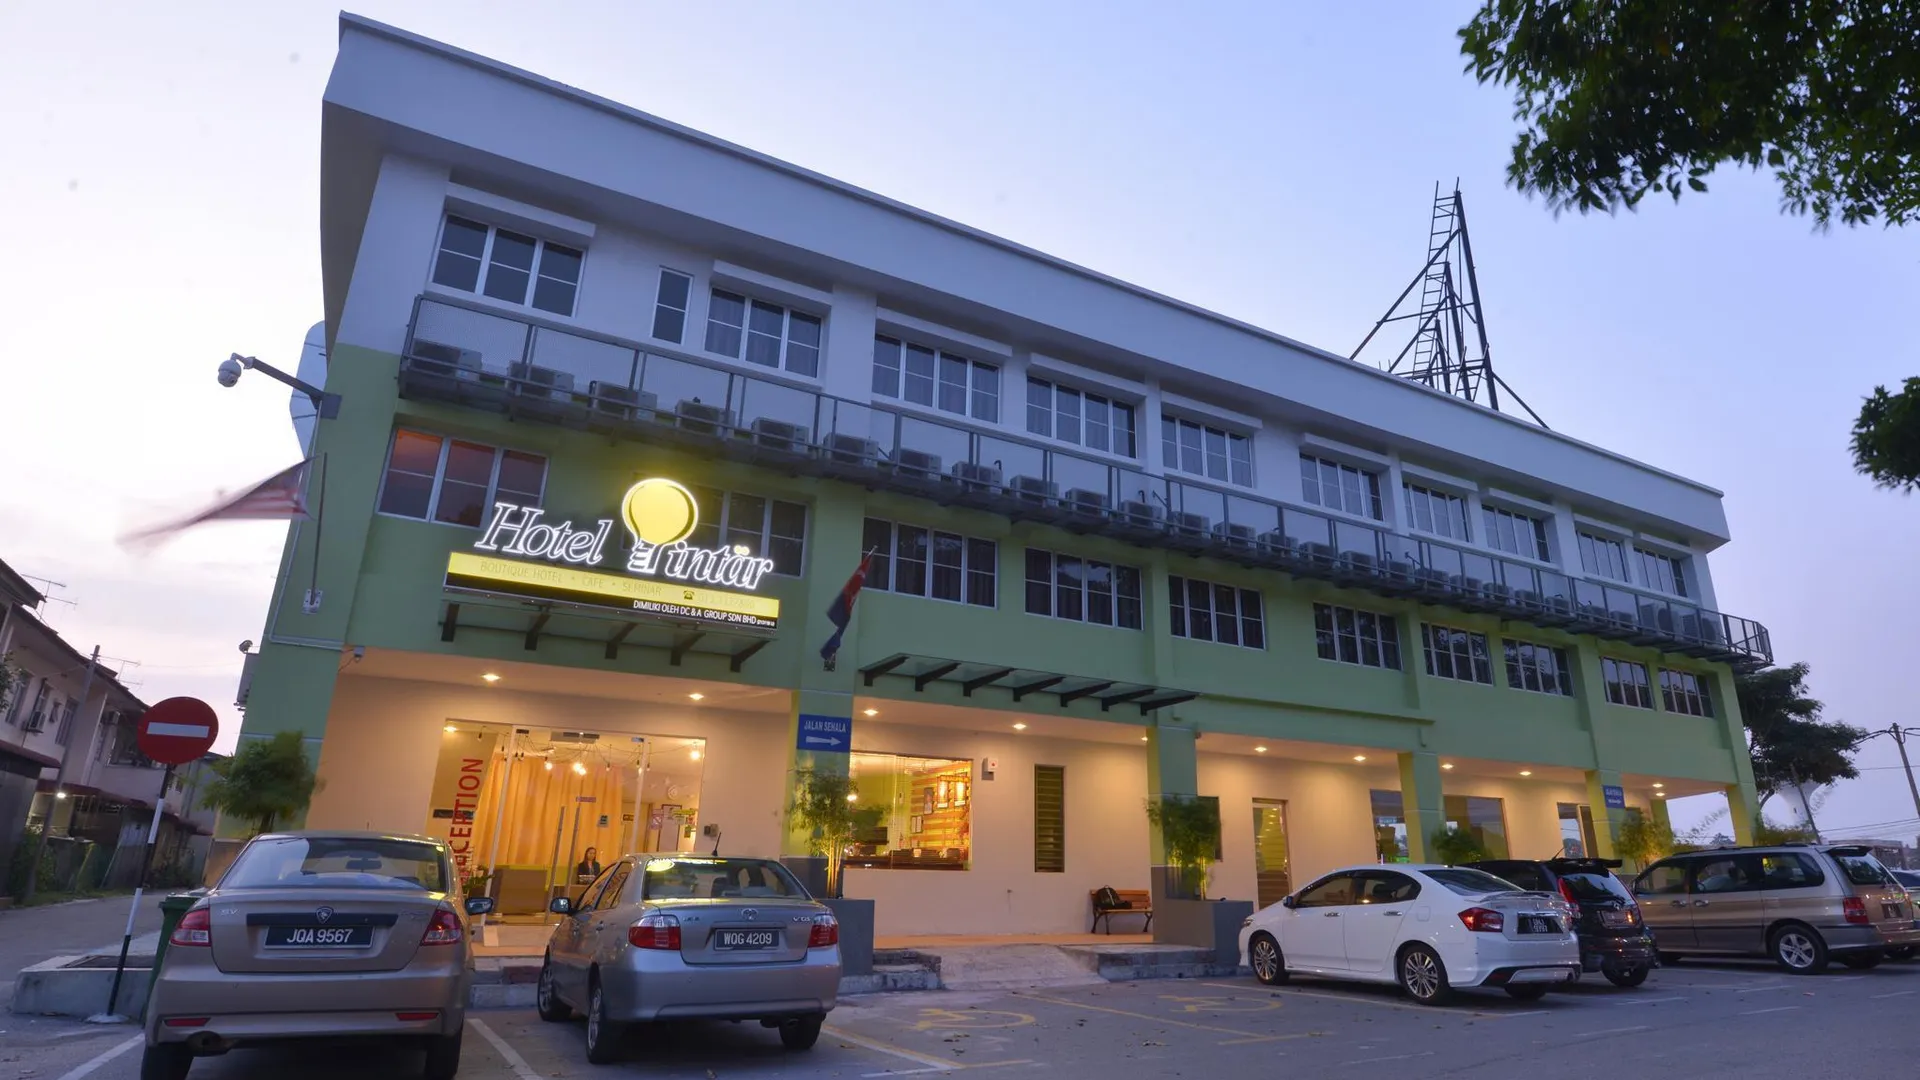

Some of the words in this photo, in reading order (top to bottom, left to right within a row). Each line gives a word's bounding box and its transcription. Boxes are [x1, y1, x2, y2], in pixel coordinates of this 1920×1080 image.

[474, 501, 613, 565] Hotel
[480, 561, 529, 578] BOUTIQUE
[533, 568, 563, 584] HOTEL
[622, 581, 661, 596] SEMINAR
[633, 600, 661, 612] DIMILIKI
[661, 604, 680, 614] OLEH
[680, 606, 690, 616] DC
[690, 608, 697, 617] &
[697, 609, 702, 617] A
[704, 610, 728, 620] GROUP
[727, 613, 742, 623] SDN
[742, 615, 757, 625] BHD
[804, 720, 823, 731] JALAN
[287, 928, 314, 943] JQA
[316, 928, 353, 943] 9567
[746, 932, 772, 945] 4209
